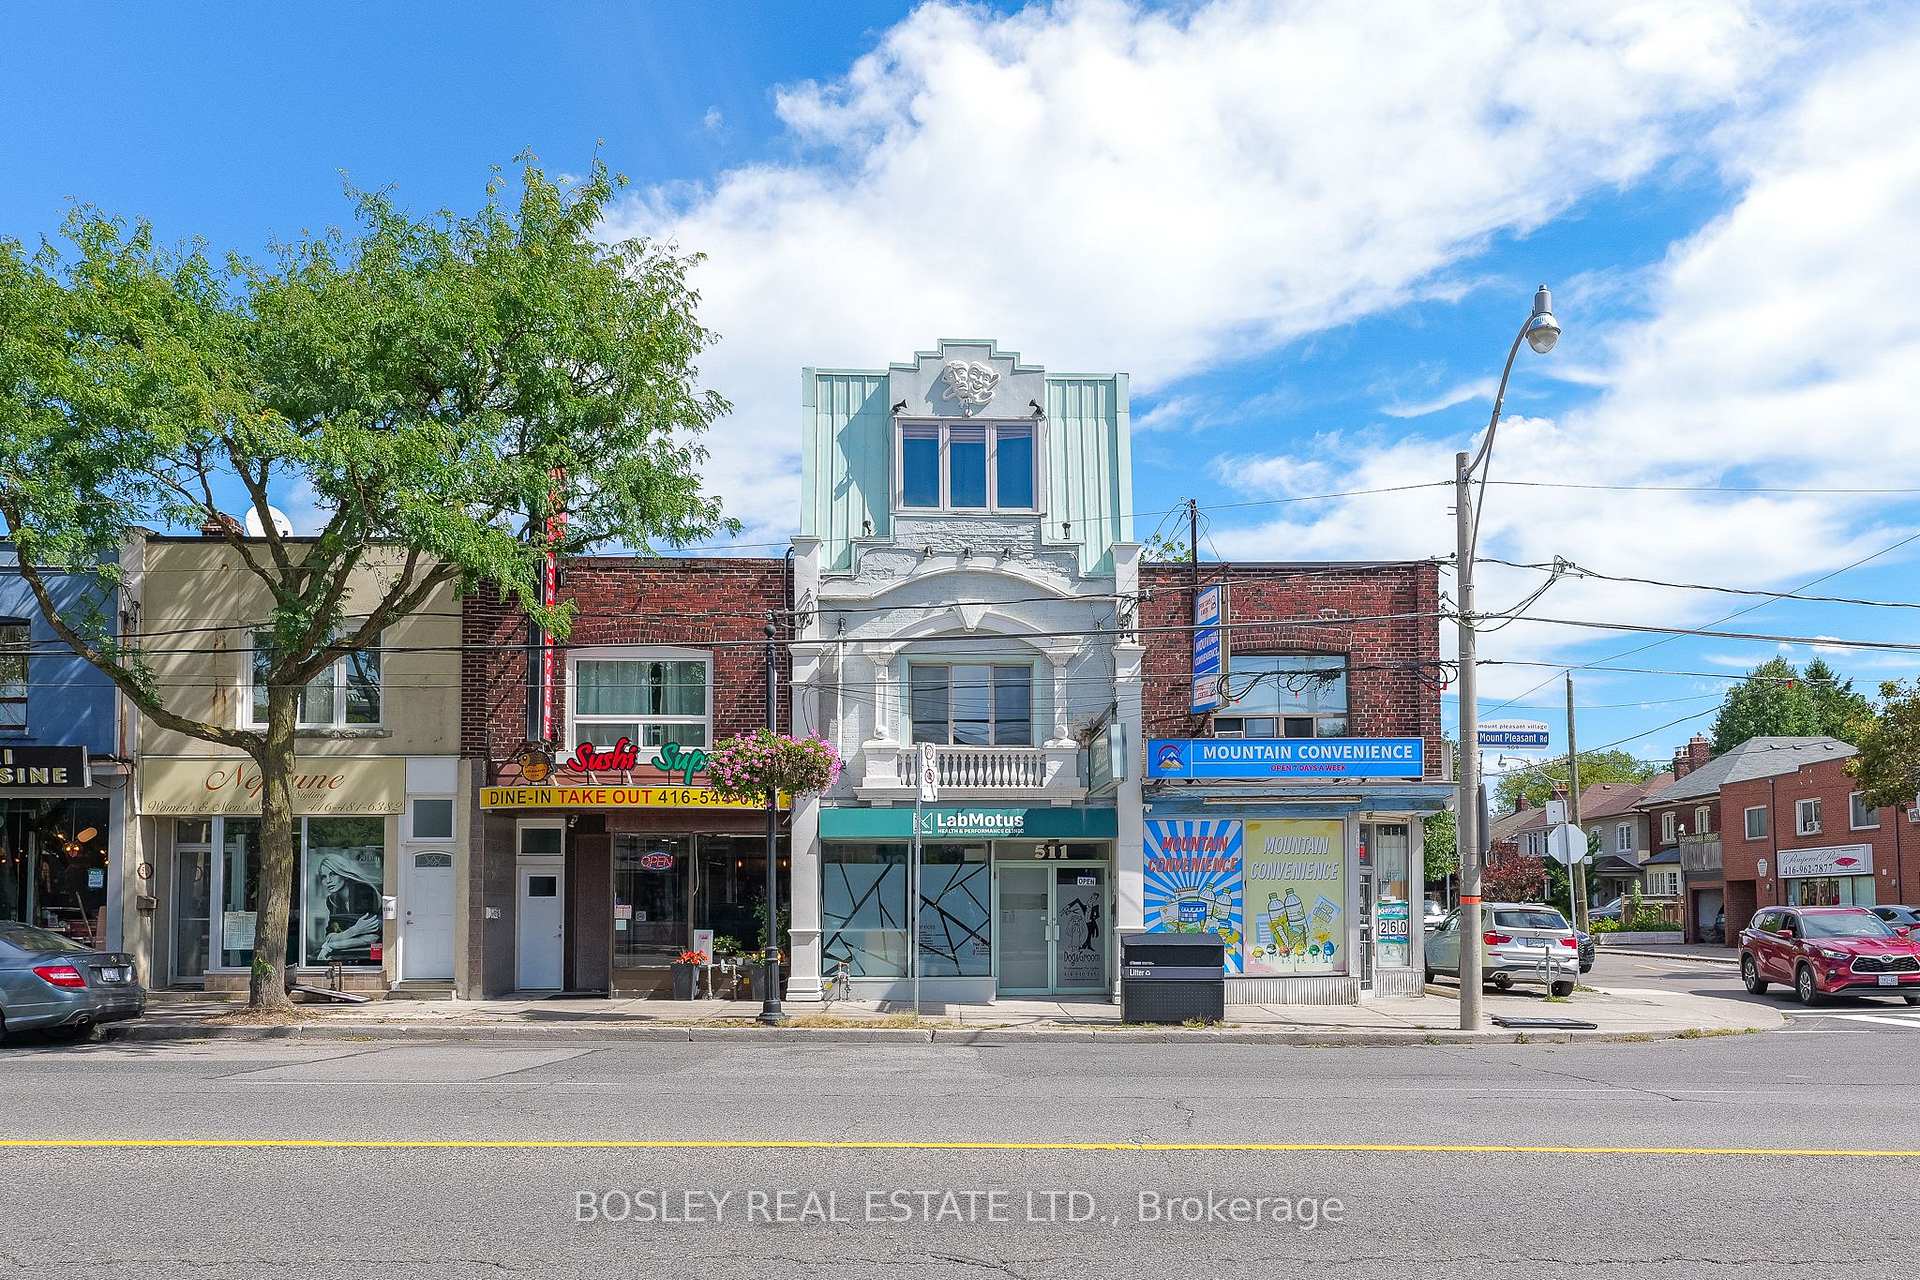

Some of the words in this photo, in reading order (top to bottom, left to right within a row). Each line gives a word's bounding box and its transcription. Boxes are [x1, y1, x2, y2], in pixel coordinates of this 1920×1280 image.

[1527, 723, 1548, 731] village
[1479, 732, 1503, 743] Mount
[1504, 732, 1537, 743] Pleasant
[1539, 734, 1548, 743] Rd
[566, 736, 640, 773] Sushi
[1203, 745, 1292, 760] MOUNTAIN
[1298, 745, 1413, 759] CONVENIENCE
[0, 767, 68, 784] SINE
[1270, 764, 1292, 772] OPEN
[1299, 764, 1318, 772] DAYS
[1325, 764, 1345, 772] WEEK
[205, 761, 344, 799] Neune
[490, 790, 551, 805] DINE-IN
[557, 789, 606, 804] TAKE
[612, 789, 653, 804] OUT
[148, 800, 195, 812] Women's
[212, 801, 248, 812] Men's
[937, 812, 1025, 828] LabMotus
[1034, 844, 1069, 859] 511
[1161, 836, 1229, 852] MOUNTAIN
[1263, 836, 1329, 855] MOUNTAIN
[640, 855, 674, 869] OPEN
[1147, 857, 1239, 874] CONVENIENCE
[1783, 863, 1833, 875] 416-962-7877
[1250, 861, 1339, 881] CONVENIENCE
[1079, 877, 1095, 885] OPEN
[1129, 968, 1145, 977] Litter
